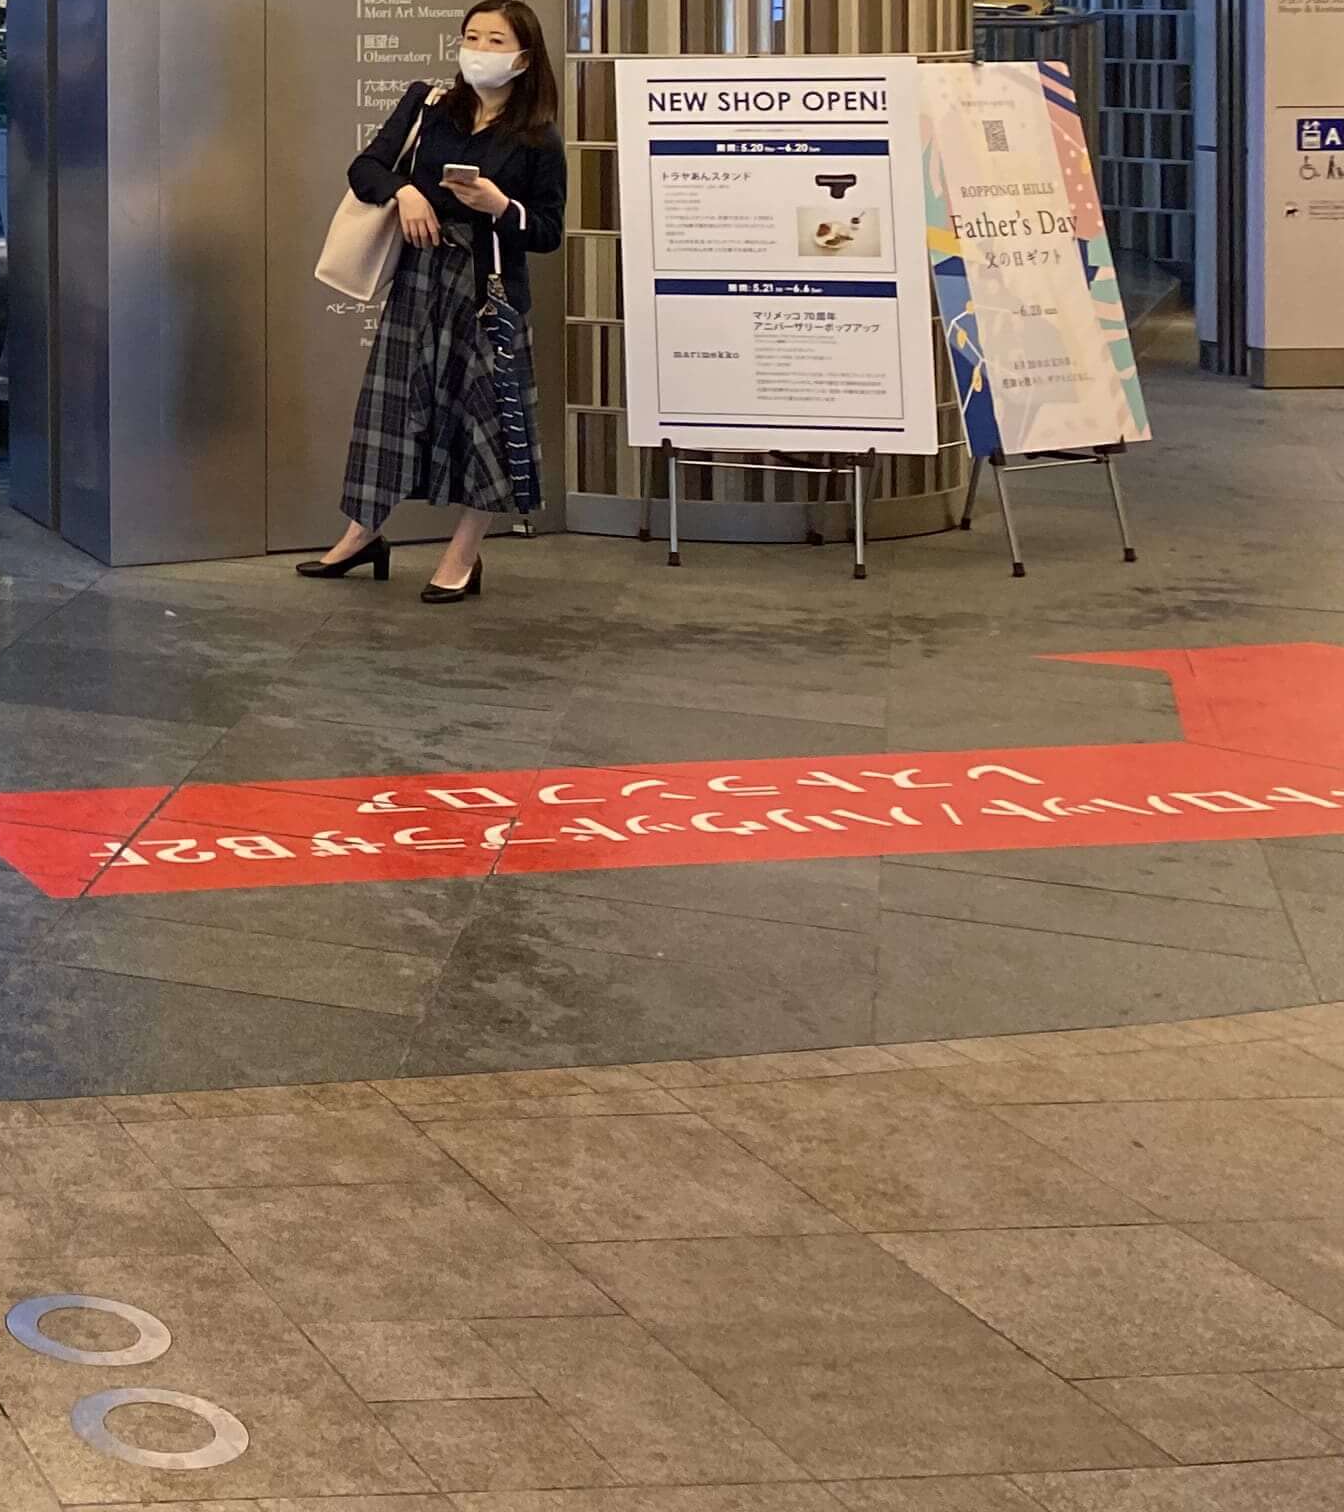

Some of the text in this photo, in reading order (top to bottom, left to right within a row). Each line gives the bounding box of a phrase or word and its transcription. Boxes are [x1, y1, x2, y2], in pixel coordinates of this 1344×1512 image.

[365, 6, 465, 19] Mori Art Museum
[364, 33, 400, 49] 展望台
[364, 51, 433, 65] Observatory
[364, 95, 400, 111] Roppo
[648, 89, 888, 113] NEW SHOP OPEN!
[1325, 127, 1342, 146] A
[960, 182, 1055, 199] ROPPONGI HILLS
[949, 210, 1078, 240] Father's Day
[985, 249, 1062, 270] 父の日ギフト
[752, 311, 801, 321] マリメッコ
[673, 350, 740, 360] marimekko
